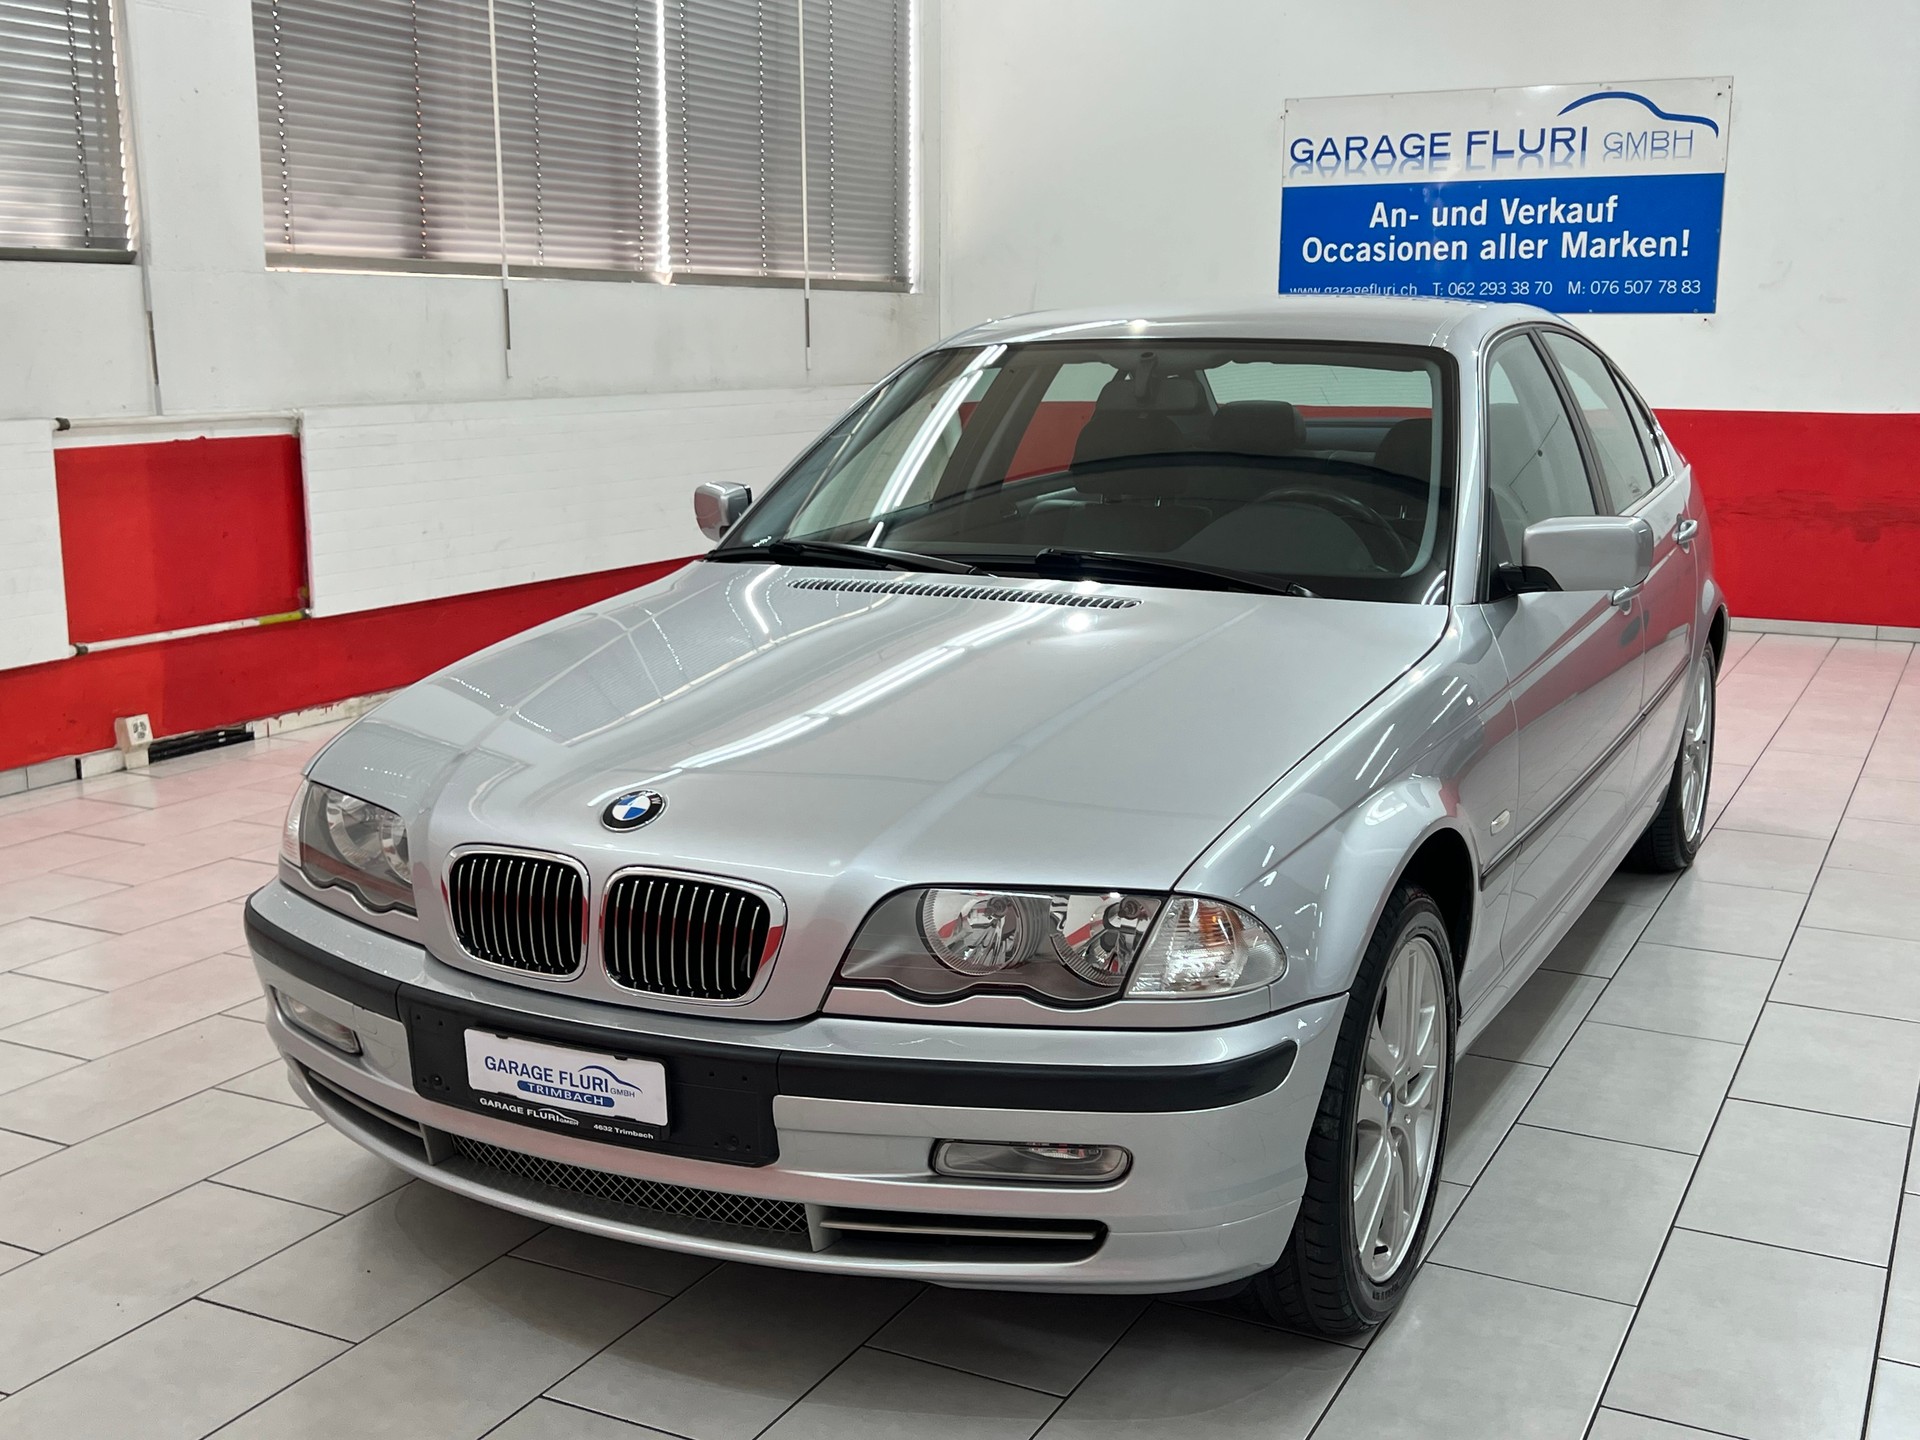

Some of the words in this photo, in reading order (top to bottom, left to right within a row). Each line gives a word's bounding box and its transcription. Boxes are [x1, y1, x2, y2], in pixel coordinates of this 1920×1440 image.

[1290, 131, 1451, 163] GARAGE
[1467, 126, 1587, 155] FLURI
[1603, 129, 1694, 151] GMBH
[1369, 201, 1419, 228] An-
[1432, 198, 1487, 227] und
[1500, 194, 1618, 225] Verkauf
[1302, 235, 1468, 263] Occasionen
[1479, 232, 1548, 260] aller
[1561, 229, 1690, 259] Marken!
[1433, 282, 1443, 296] T:
[1448, 282, 1475, 296] 062
[1479, 281, 1506, 295] 293
[1510, 281, 1530, 295] 38
[1534, 281, 1553, 295] 70
[1567, 281, 1586, 295] M:
[1590, 280, 1619, 294] 076
[1623, 280, 1652, 294] 507
[1658, 280, 1676, 294] 78
[1680, 279, 1701, 294] 83
[484, 1056, 554, 1083] GARAGE
[559, 1071, 609, 1093] FLURI
[610, 1087, 636, 1098] GMBH
[527, 1082, 604, 1106] TRIMBACH
[479, 1097, 524, 1115] GARAGE
[526, 1108, 559, 1122] FLURI
[593, 1124, 613, 1133] 4632
[614, 1127, 654, 1140] Trimbach
